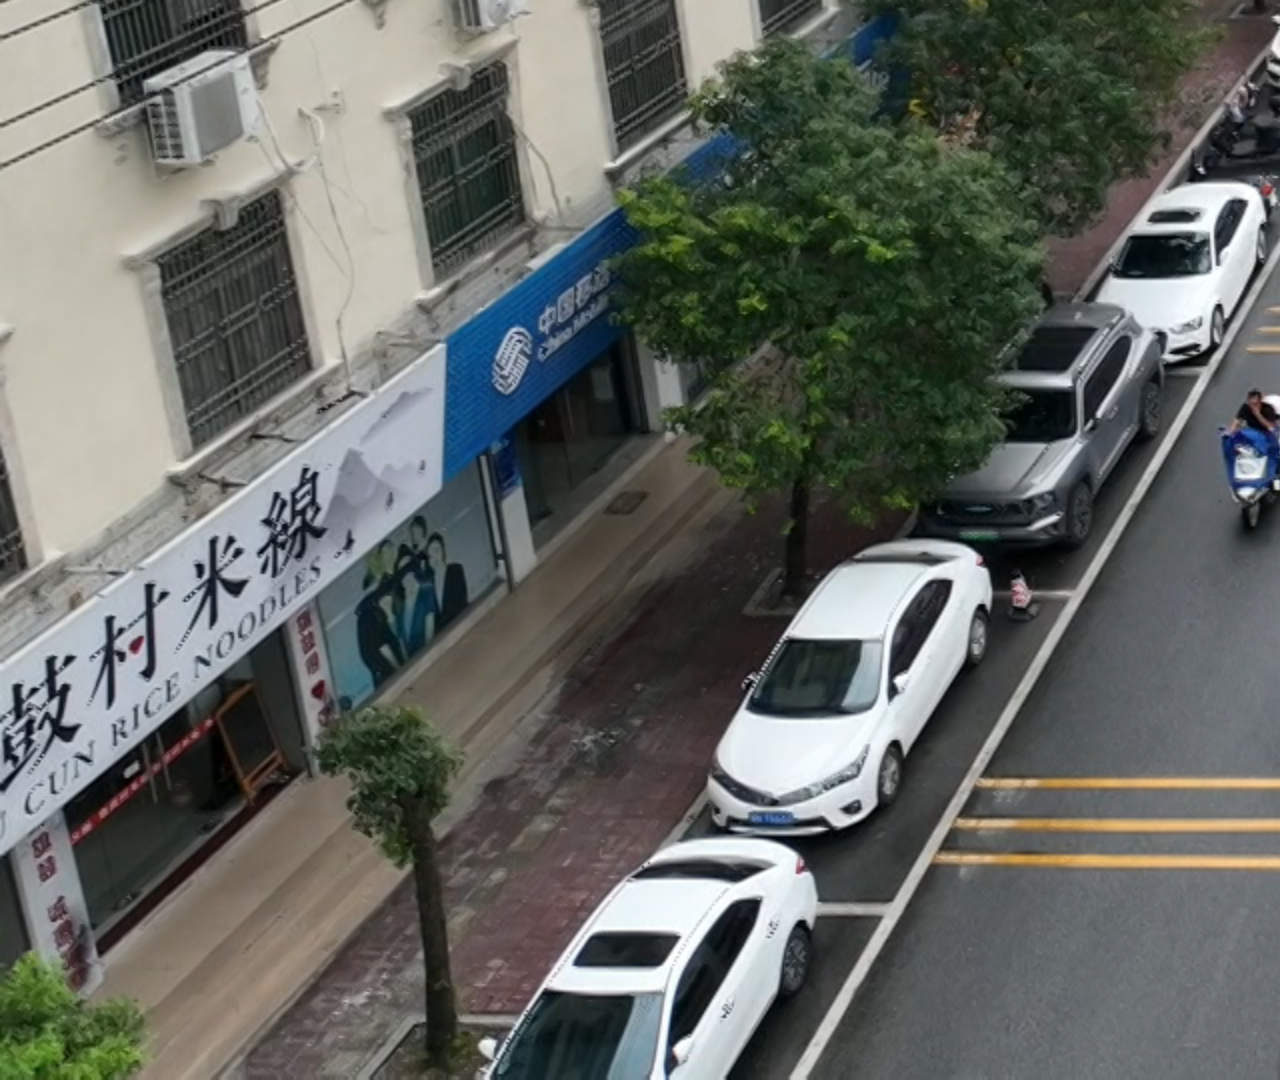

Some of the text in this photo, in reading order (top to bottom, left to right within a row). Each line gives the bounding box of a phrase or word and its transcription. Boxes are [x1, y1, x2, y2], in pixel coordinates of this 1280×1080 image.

[24, 739, 95, 817] CUN
[111, 672, 181, 749] RICE
[194, 555, 323, 680] NOODLES
